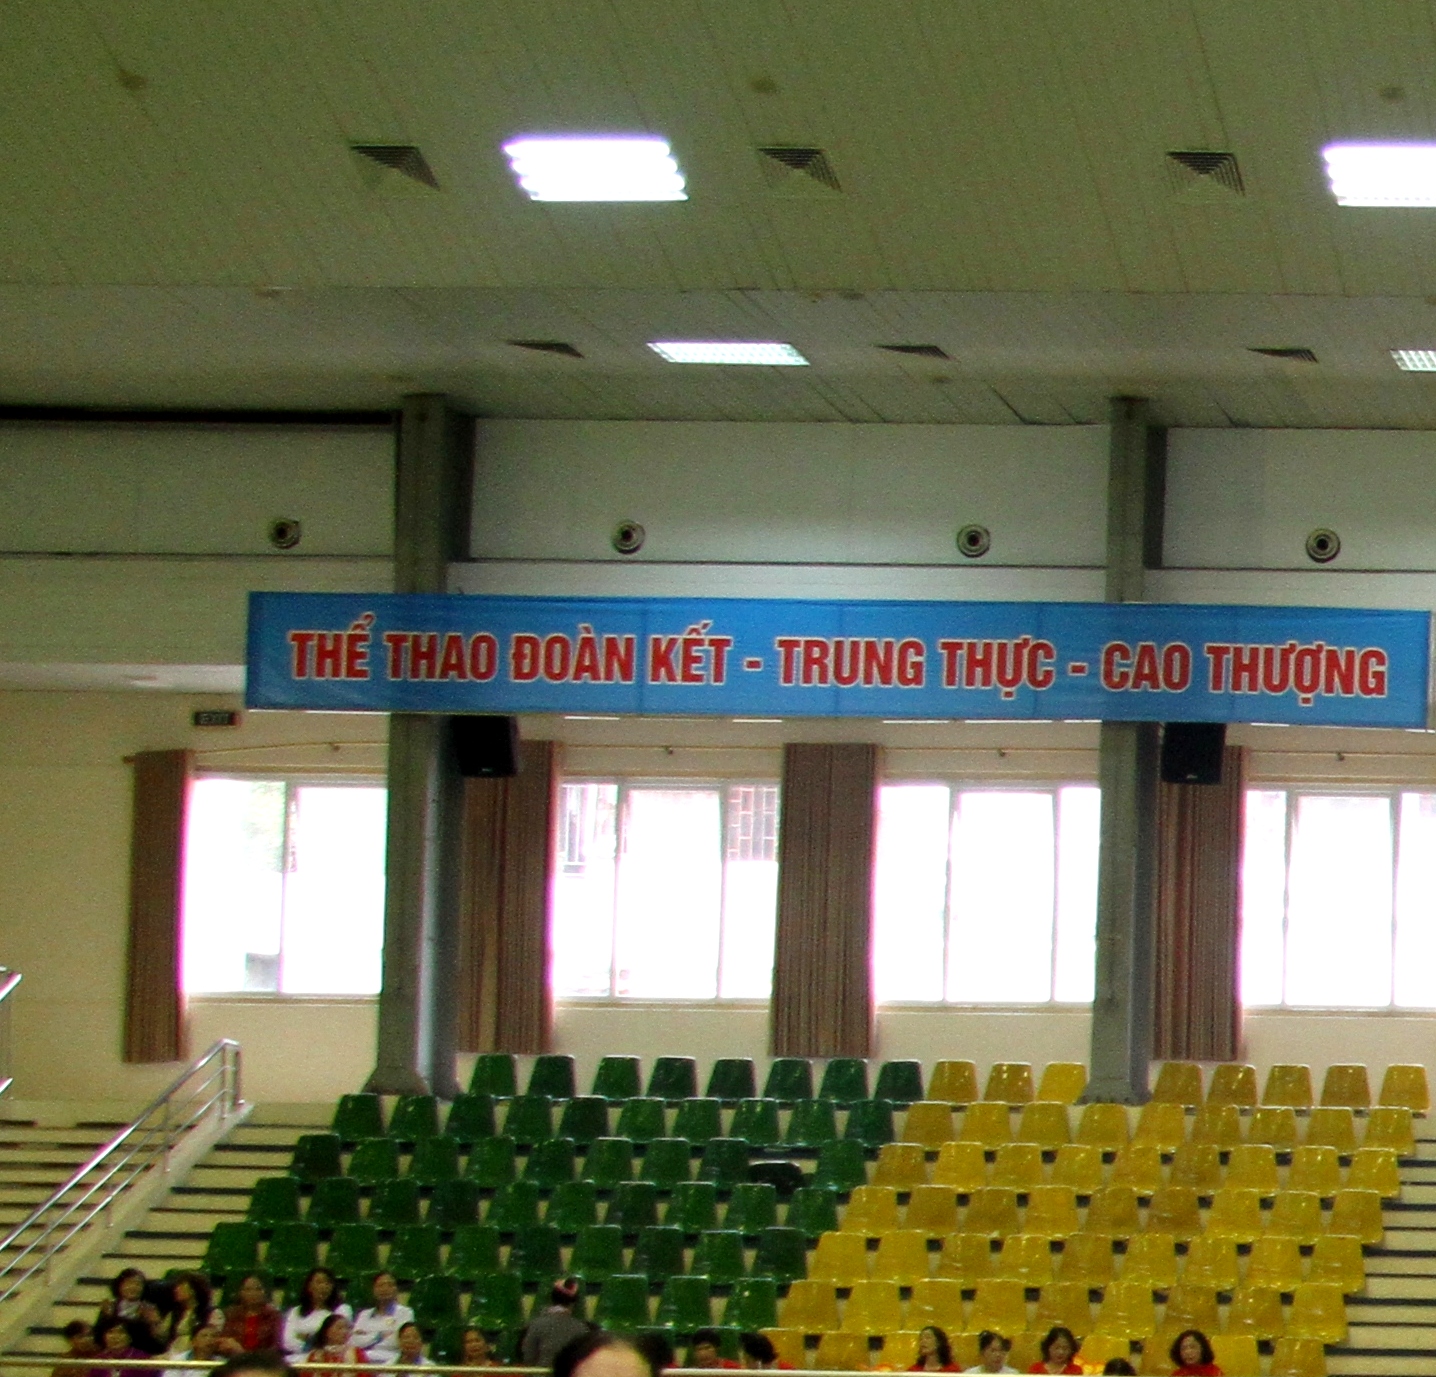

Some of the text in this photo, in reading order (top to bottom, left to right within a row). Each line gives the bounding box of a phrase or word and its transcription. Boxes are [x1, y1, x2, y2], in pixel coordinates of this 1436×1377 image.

[288, 612, 375, 682] THỂ
[384, 631, 498, 683] THAO
[510, 623, 636, 684] ĐOÀN
[648, 620, 733, 684] KẾT
[776, 636, 925, 689] TRUNG
[938, 634, 1056, 700] THỰC
[1101, 641, 1191, 692] CAO
[1204, 640, 1388, 706] THƯỢNG
